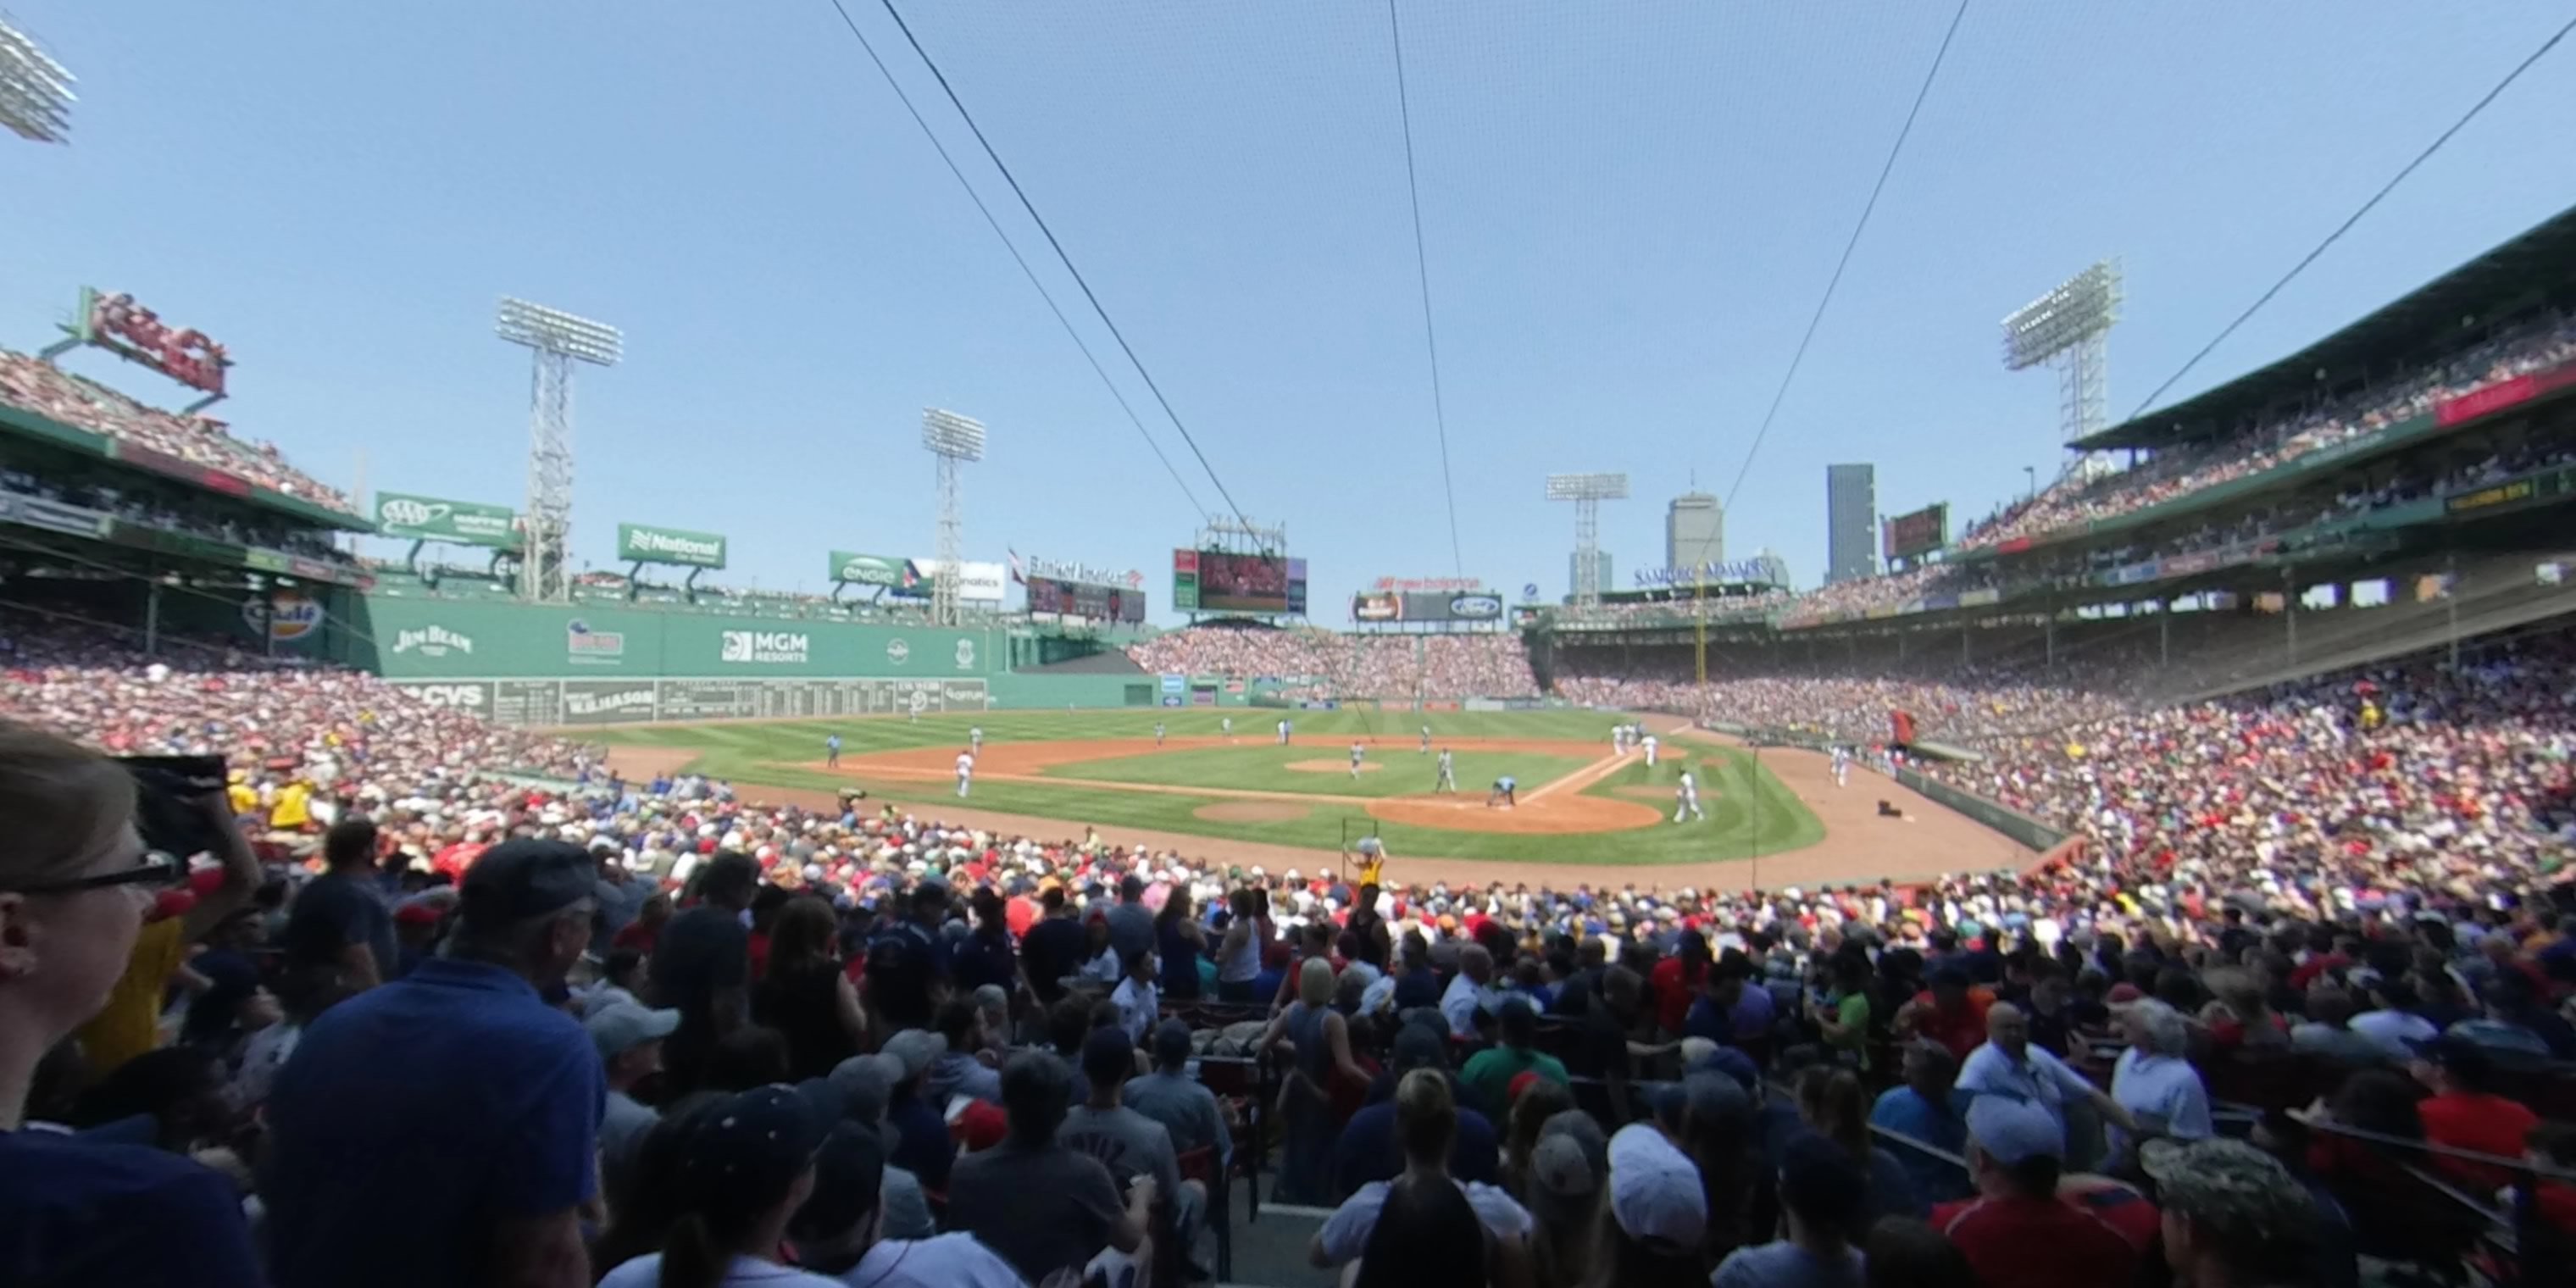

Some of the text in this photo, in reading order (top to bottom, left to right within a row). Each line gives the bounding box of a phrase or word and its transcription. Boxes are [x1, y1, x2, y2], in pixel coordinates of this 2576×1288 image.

[651, 530, 719, 556] National
[755, 632, 808, 651] MGM
[755, 652, 807, 662] RESORTS
[424, 685, 483, 706] CVS
